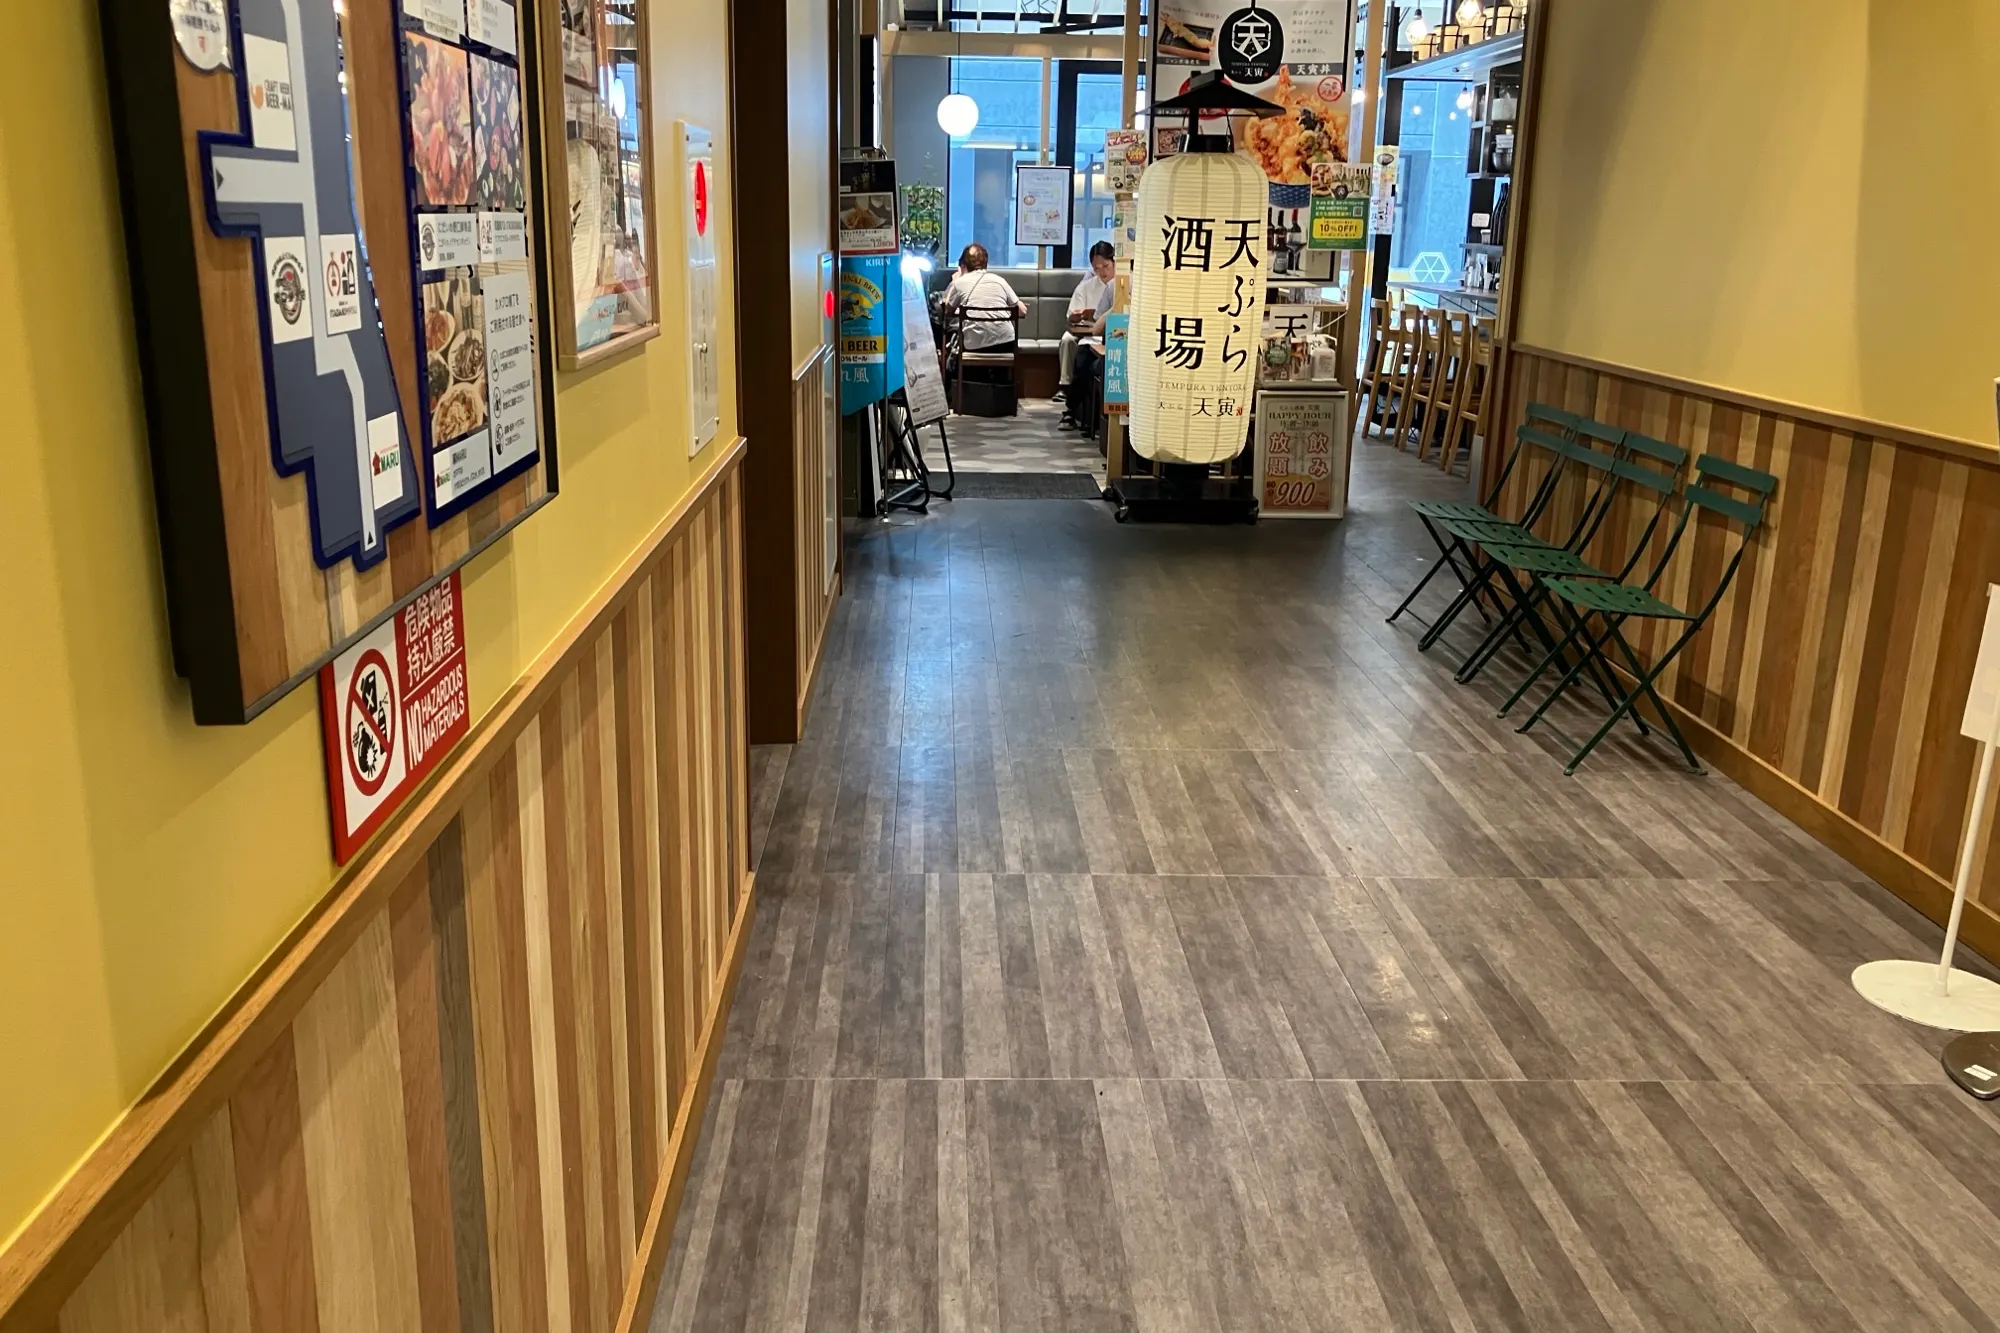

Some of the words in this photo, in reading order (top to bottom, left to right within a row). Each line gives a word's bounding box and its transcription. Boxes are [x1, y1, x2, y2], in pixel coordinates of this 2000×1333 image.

[866, 258, 891, 267] KIRIN
[1154, 214, 1216, 370] 酒場
[1218, 219, 1261, 373] 天ぷら
[847, 340, 878, 351] BEER
[1107, 347, 1122, 394] 晴れ風
[1159, 380, 1206, 391] TEMPURA
[1192, 396, 1236, 417] 天寅
[1269, 412, 1301, 420] HAPPY
[1303, 412, 1332, 420] HOUR
[380, 450, 400, 473] MARU
[1267, 431, 1290, 478] 放題
[1308, 432, 1329, 478] 飲み
[1274, 480, 1316, 505] 900
[404, 576, 453, 646] 危険物品
[407, 615, 456, 688] 持込厳禁
[406, 700, 424, 771] NO
[422, 663, 463, 723] HAZARDOUS
[423, 691, 464, 752] MATERIALS
